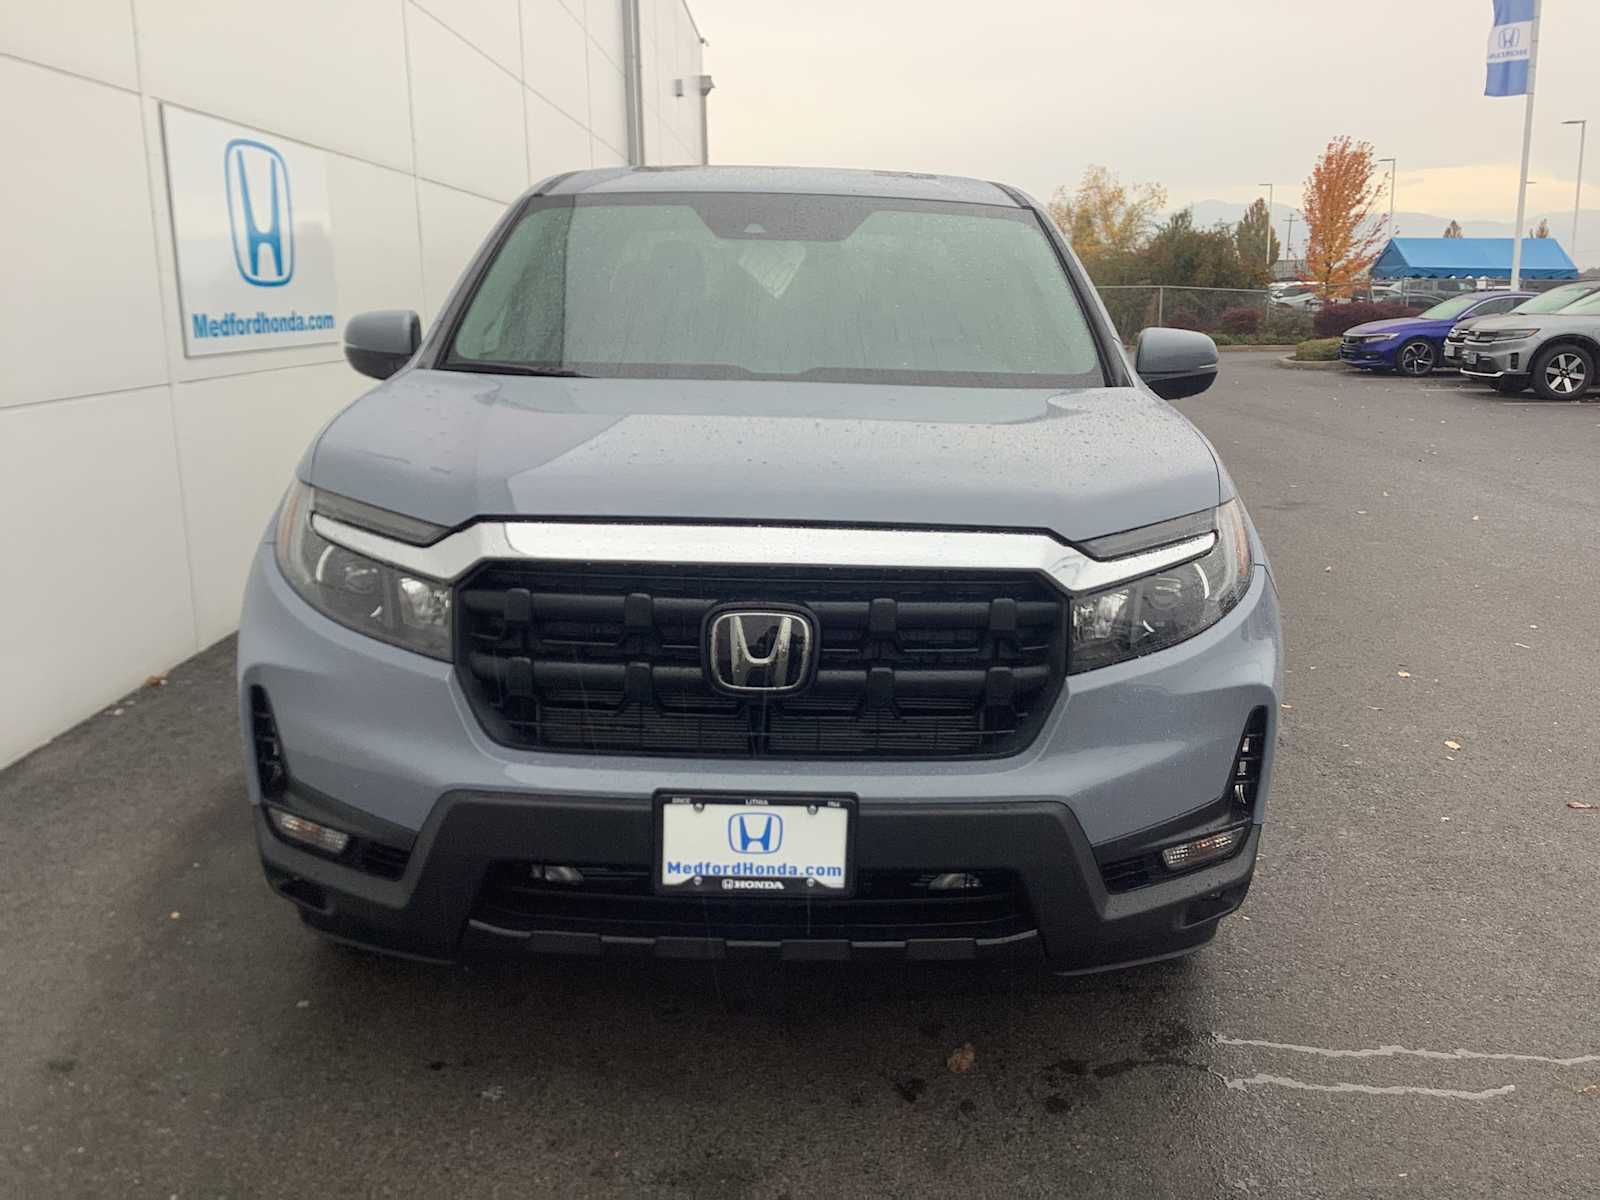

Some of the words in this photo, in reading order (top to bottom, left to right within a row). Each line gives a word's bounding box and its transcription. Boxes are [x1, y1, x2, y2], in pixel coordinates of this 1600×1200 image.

[192, 311, 335, 339] Medfordhonda.com
[667, 862, 842, 877] MedfordHonda.com
[733, 880, 785, 890] HONDA
